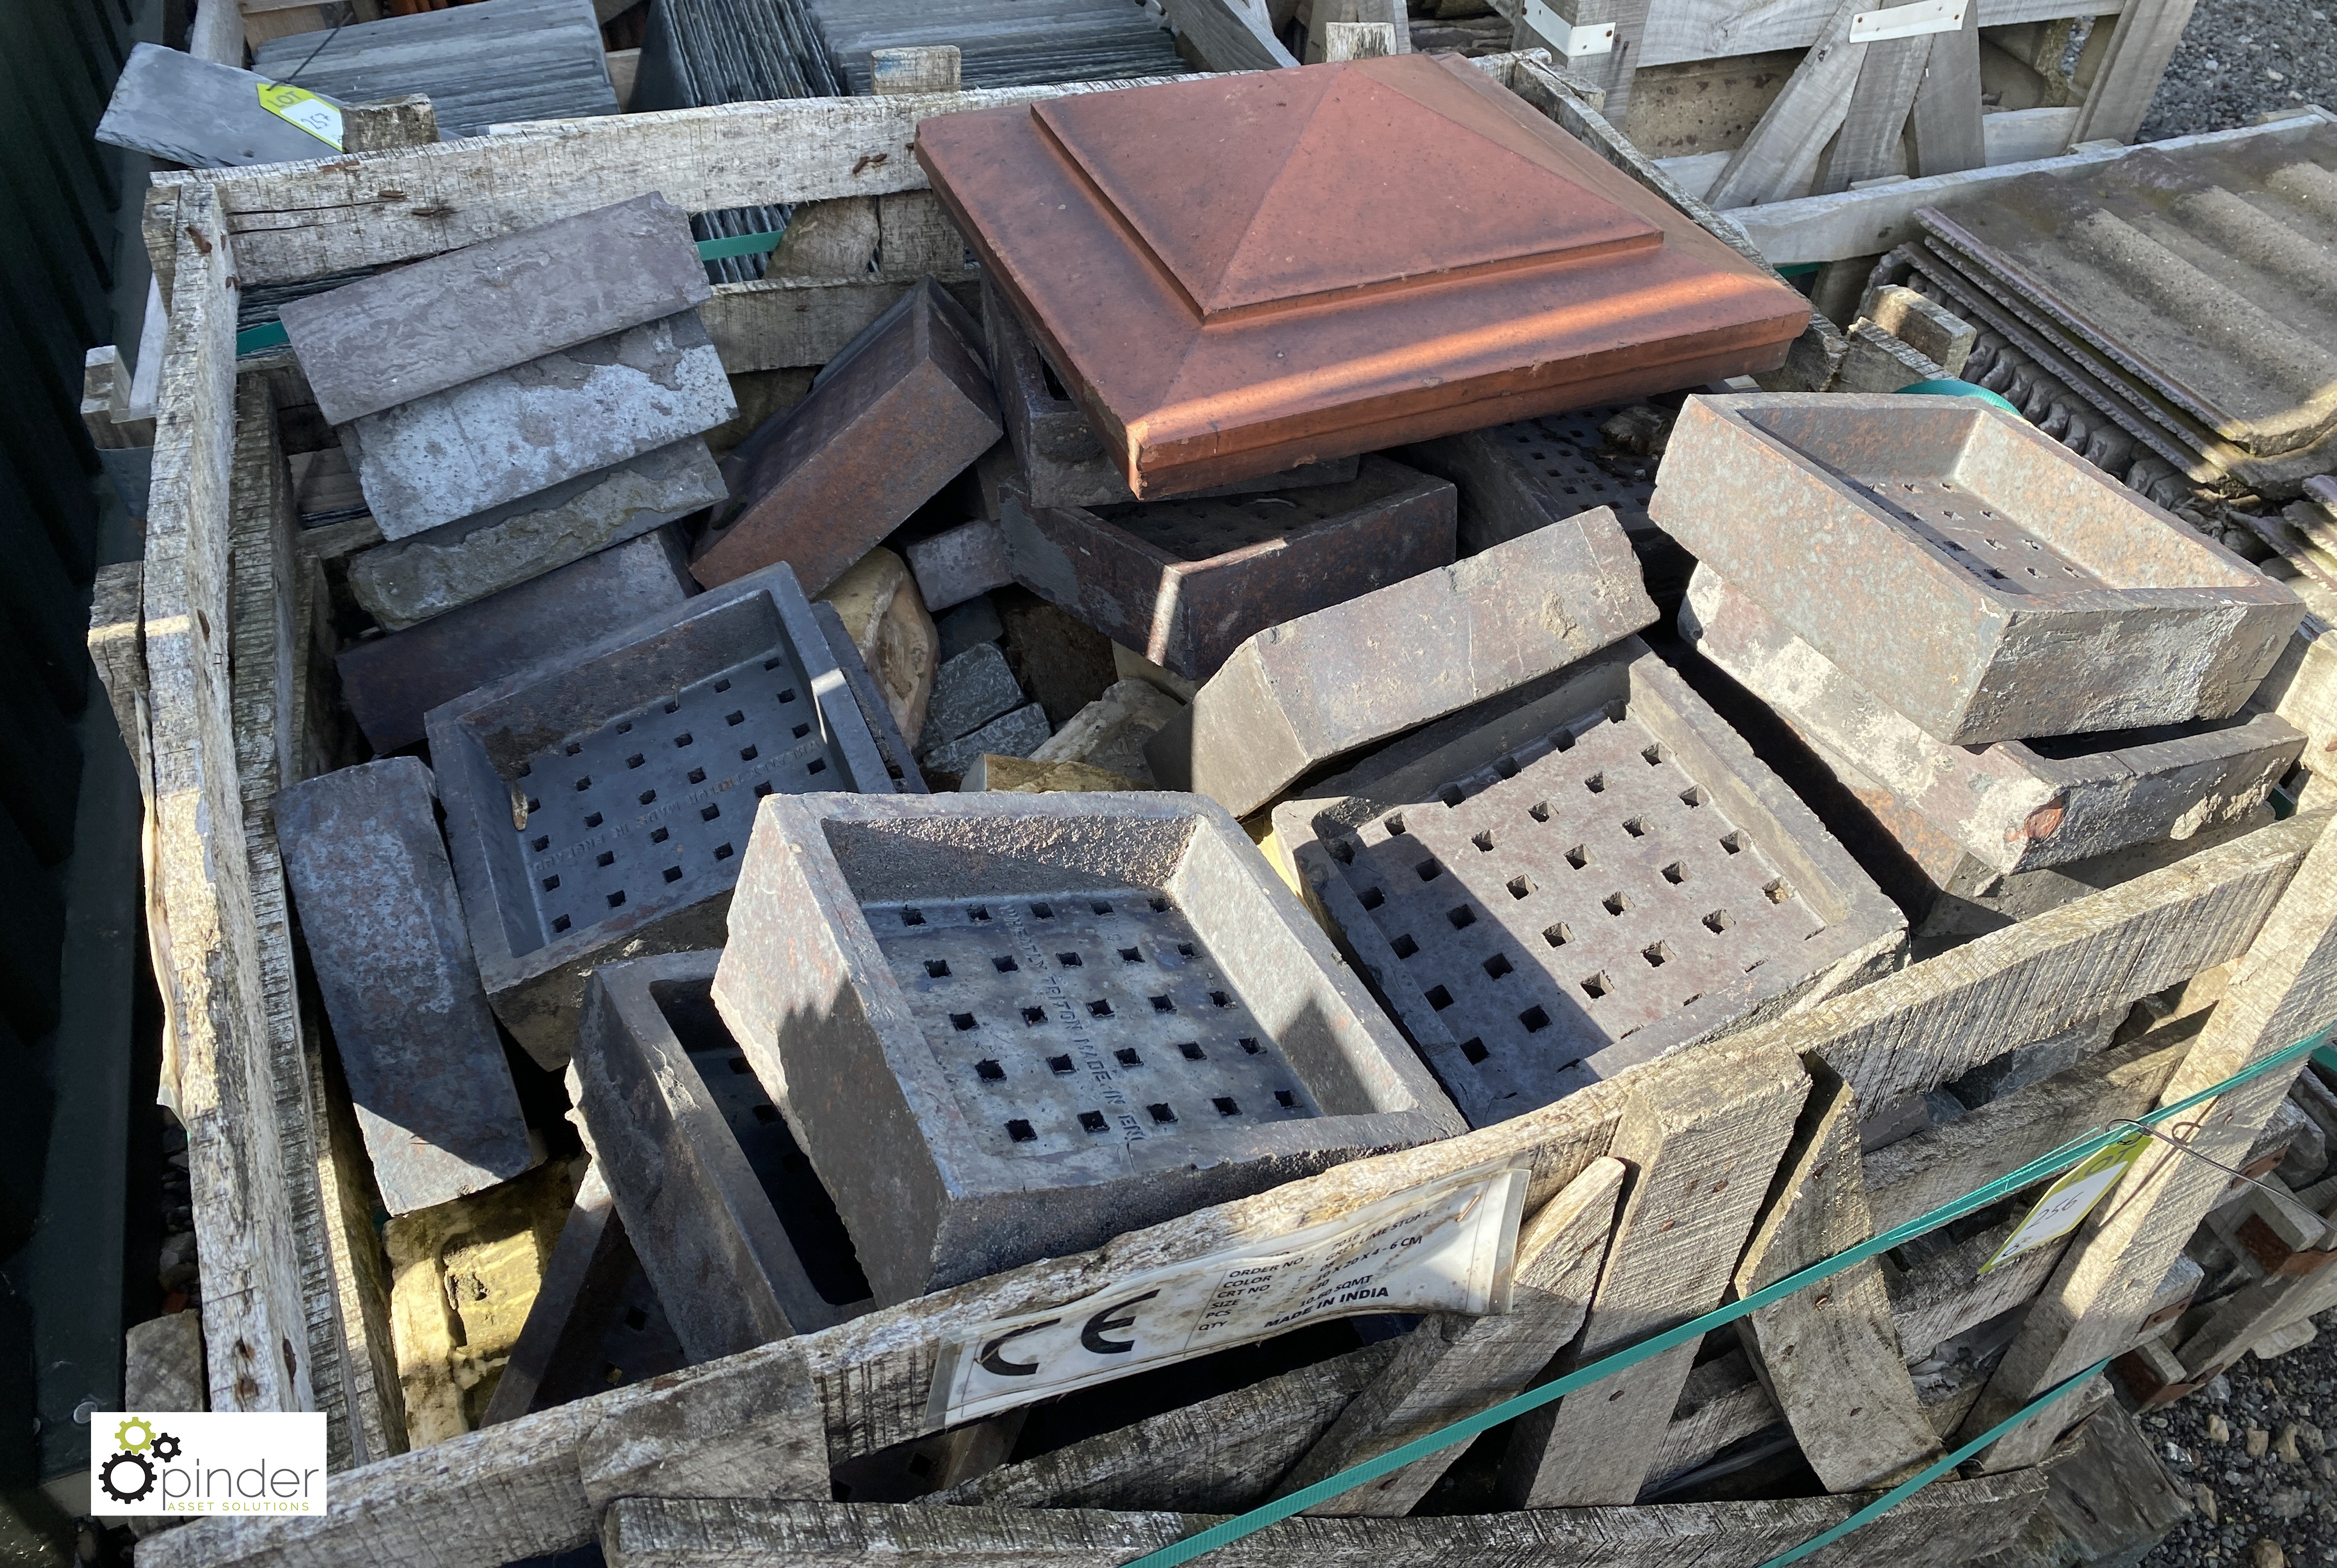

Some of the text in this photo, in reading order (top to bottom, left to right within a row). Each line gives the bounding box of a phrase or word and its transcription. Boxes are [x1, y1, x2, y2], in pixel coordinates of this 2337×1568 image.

[267, 91, 301, 108] LOT
[301, 113, 329, 129] 257
[636, 803, 679, 827] MADE
[1042, 973, 1083, 1030] TRITON
[1073, 1038, 1112, 1082] MADE
[1101, 1089, 1126, 1105] IN
[2066, 1145, 2135, 1187] LOT
[2026, 1191, 2085, 1230] 256
[1211, 1299, 1241, 1310] SIZE
[1343, 1257, 1359, 1268] 20
[1371, 1248, 1380, 1256] 4
[1389, 1241, 1397, 1250] 6
[1401, 1235, 1423, 1247] CM
[1223, 1275, 1272, 1289] COLOR
[1326, 1242, 1358, 1261] GREY
[1360, 1227, 1388, 1245] LIME
[1230, 1264, 1280, 1278] ORDER
[1282, 1257, 1304, 1268] NO
[1331, 1231, 1362, 1250] 7016
[1199, 1321, 1229, 1331] QTY
[1334, 1274, 1374, 1293] SQMT
[1218, 1288, 1246, 1299] CRT
[1248, 1284, 1271, 1294] NO
[1264, 1286, 1389, 1328] MADE IN INDIA
[981, 1289, 1161, 1376] CE
[1206, 1309, 1232, 1319] PCS
